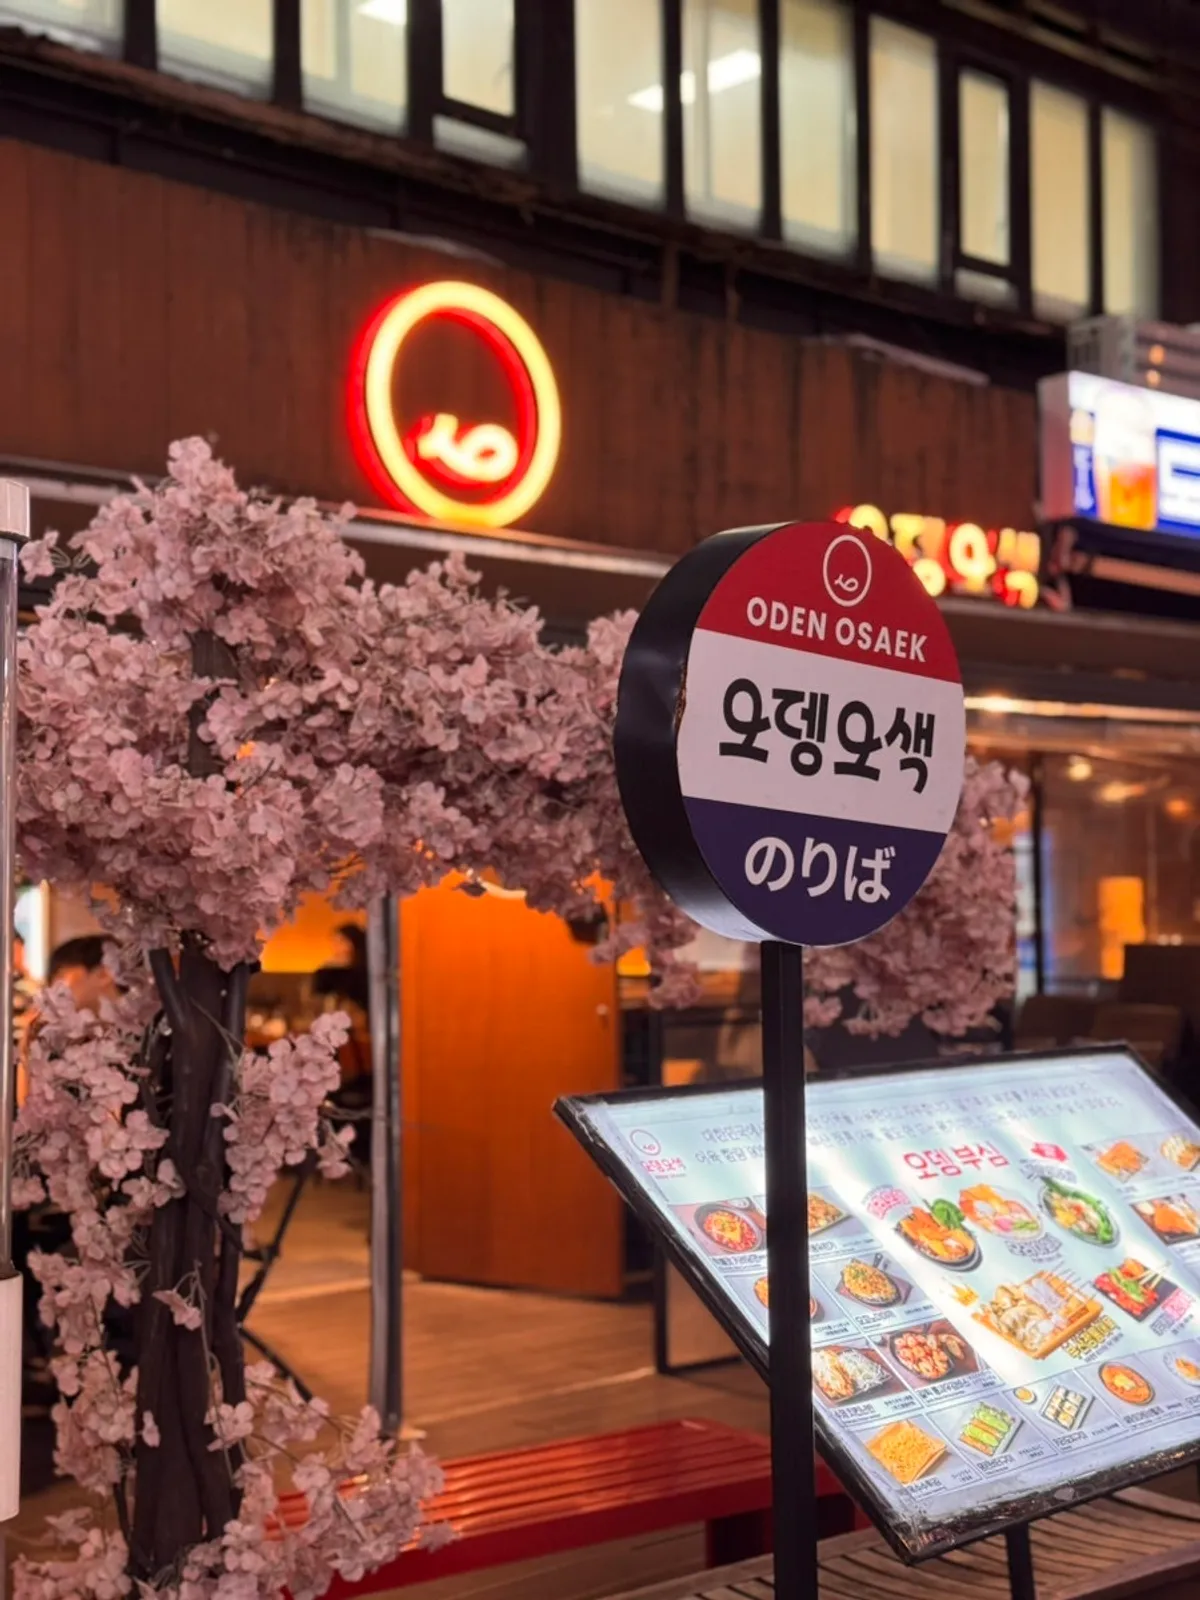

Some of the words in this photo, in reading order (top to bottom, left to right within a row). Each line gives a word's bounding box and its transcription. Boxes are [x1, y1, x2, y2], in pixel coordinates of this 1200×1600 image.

[746, 596, 828, 641] ODEN
[834, 617, 929, 664] OSAEK
[718, 677, 936, 795] 오뎅오색
[744, 836, 897, 904] のりば
